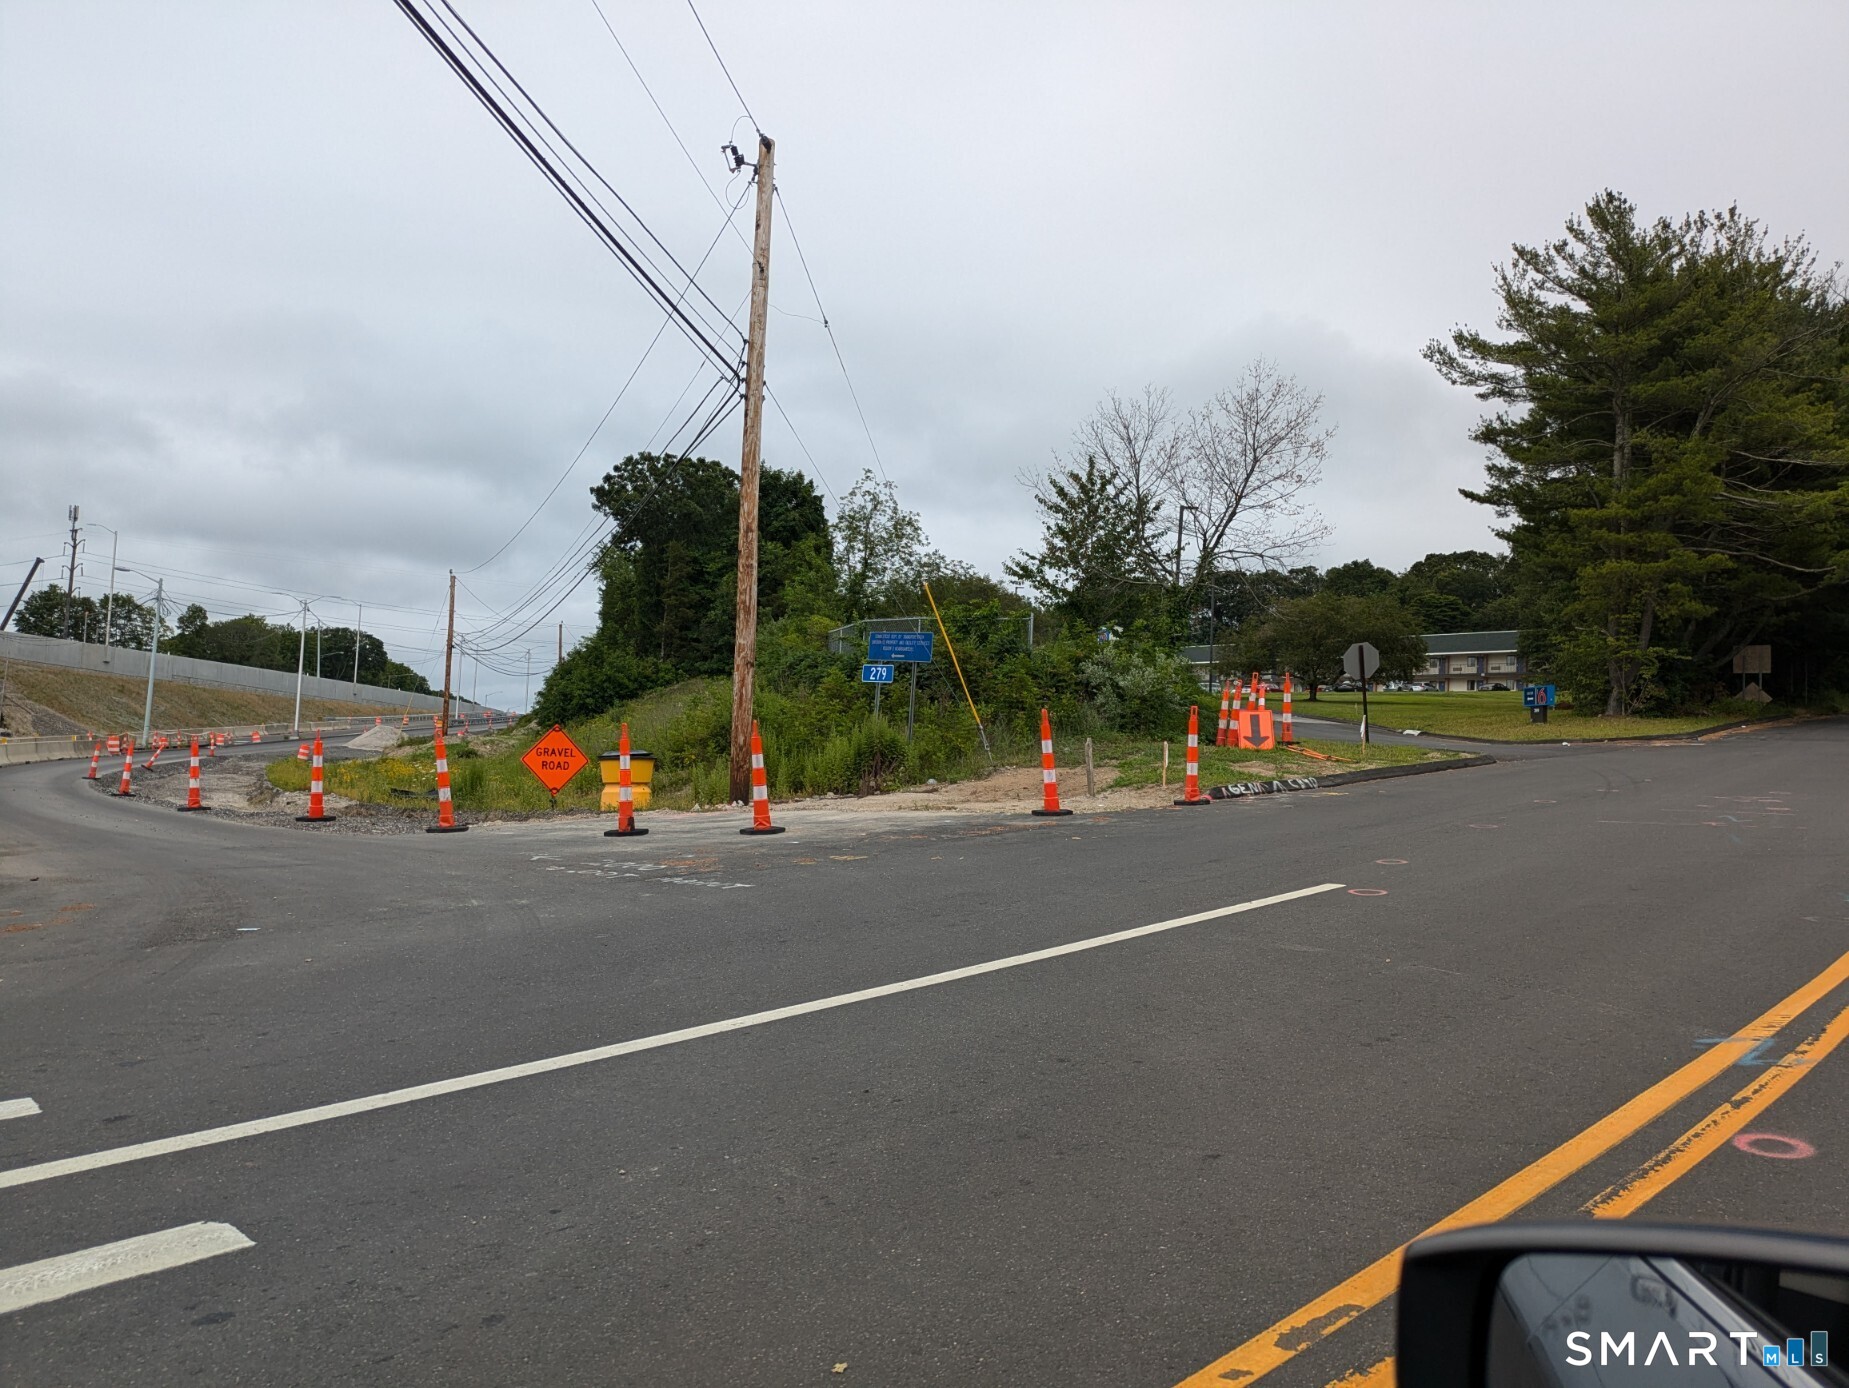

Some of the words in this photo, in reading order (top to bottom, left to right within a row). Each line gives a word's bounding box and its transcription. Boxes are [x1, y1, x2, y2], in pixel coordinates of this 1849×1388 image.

[870, 667, 886, 680] 279
[1538, 688, 1546, 704] 6
[536, 748, 576, 757] GRAVEL
[542, 761, 569, 770] ROAD
